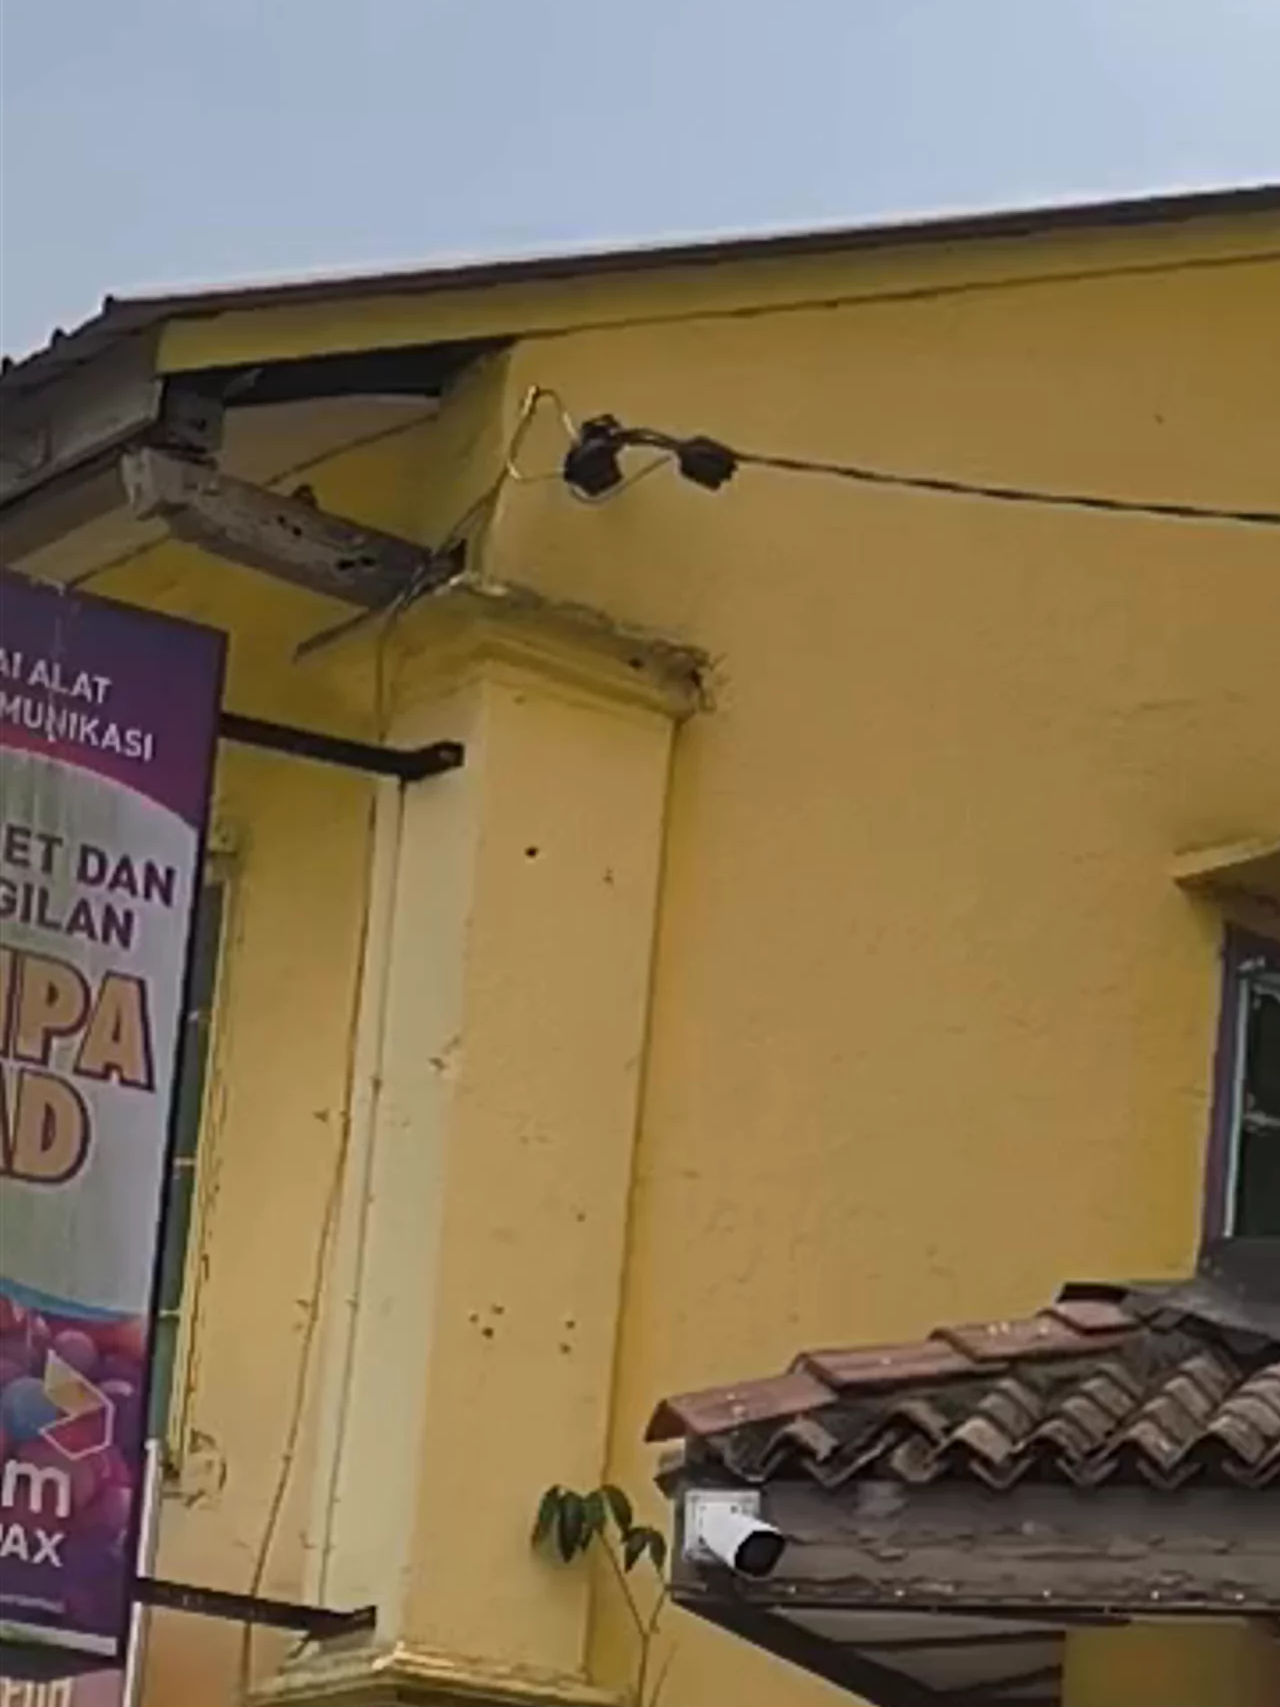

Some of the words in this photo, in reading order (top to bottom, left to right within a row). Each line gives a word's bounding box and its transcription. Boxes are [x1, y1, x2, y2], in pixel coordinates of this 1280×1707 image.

[28, 658, 112, 705] ALAT
[3, 823, 63, 876] ET
[76, 842, 176, 908] DAN
[0, 943, 155, 1094] PA
[0, 1063, 92, 1185] D
[0, 1522, 66, 1568] AX
